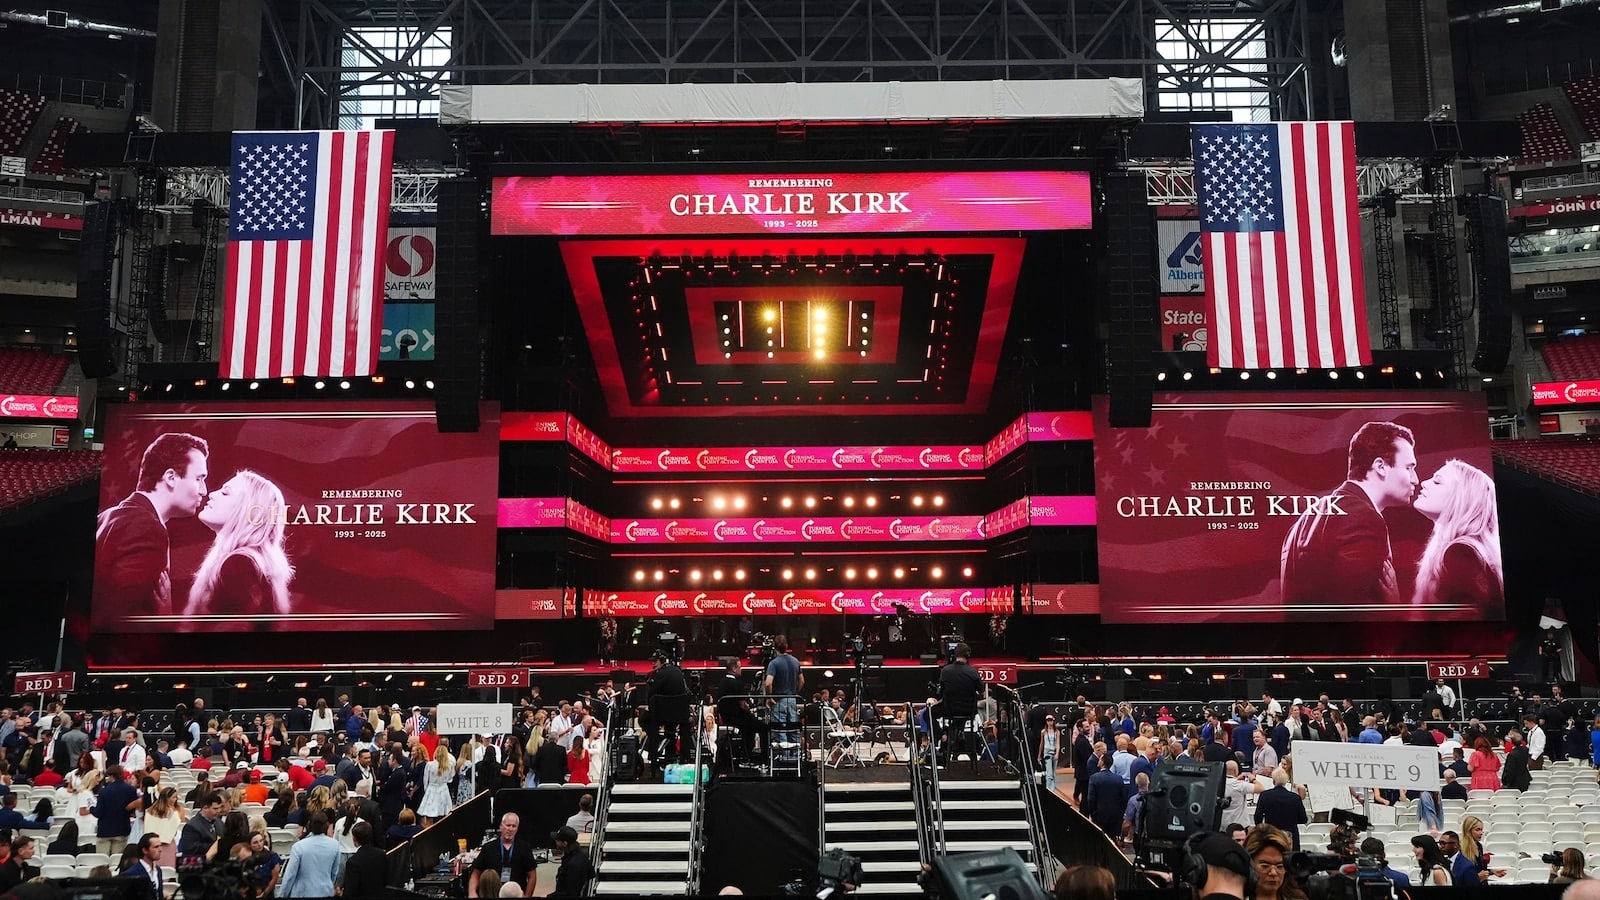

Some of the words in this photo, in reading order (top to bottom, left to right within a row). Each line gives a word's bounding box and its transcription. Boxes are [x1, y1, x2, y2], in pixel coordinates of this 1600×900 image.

[748, 180, 834, 188] REMEMBERING
[669, 192, 815, 216] CHARLIE
[827, 191, 912, 214] KIRK
[1548, 201, 1586, 214] JOHN
[0, 215, 42, 226] LMAN
[764, 220, 784, 228] 1993
[795, 219, 818, 228] 2025
[385, 281, 433, 291] SAFEWAY
[10, 432, 38, 440] SHOP
[1190, 482, 1272, 490] REMEMBERING
[322, 490, 403, 499] REMEMBERING
[1116, 496, 1255, 517] CHARLIE
[1266, 496, 1348, 516] KIRK
[248, 504, 384, 526] CHARLIE
[395, 503, 477, 525] KIRK
[1207, 522, 1228, 530] 1993
[1238, 522, 1259, 530] 2025
[365, 530, 387, 538] 2025
[1000, 671, 1007, 680] 3
[1438, 666, 1467, 676] RED
[1471, 666, 1480, 676] 4
[25, 679, 53, 690] RED
[57, 678, 63, 688] 1
[478, 674, 507, 685] RED
[511, 674, 519, 684] 2
[446, 716, 490, 728] WHITE
[495, 716, 502, 728] 8
[1310, 761, 1397, 780] WHITE
[1408, 765, 1421, 782] 9
